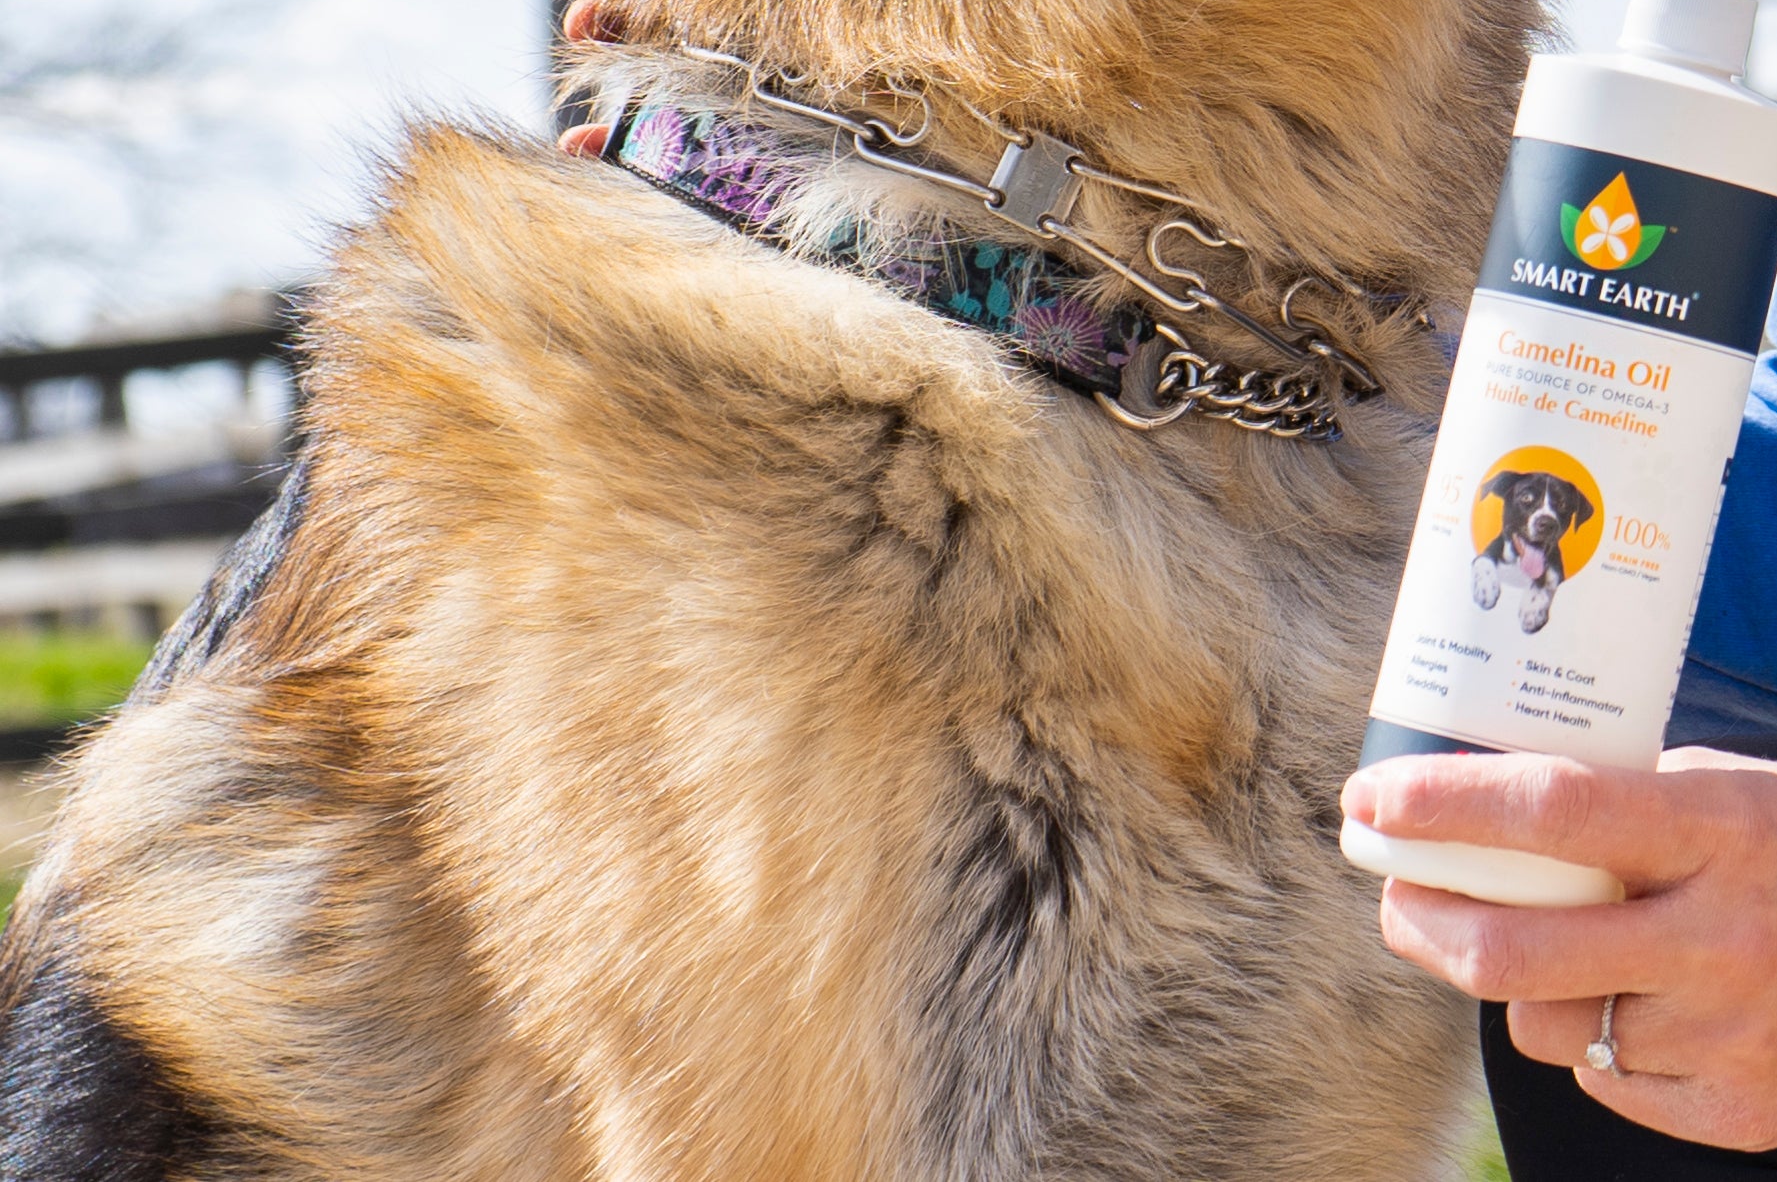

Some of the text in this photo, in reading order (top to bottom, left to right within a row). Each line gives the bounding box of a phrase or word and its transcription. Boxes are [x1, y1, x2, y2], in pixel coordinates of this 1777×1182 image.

[1511, 258, 1690, 321] SMART EARTH
[1498, 330, 1671, 392] Camelina Oil
[1484, 381, 1658, 438] Huile de Caméline
[1516, 368, 1570, 390] SOURCE
[1576, 382, 1597, 396] OF
[1602, 388, 1670, 415] OMEGA-3
[1613, 515, 1671, 550] 100%
[1438, 638, 1446, 649] &
[1448, 640, 1492, 663] Mobility
[1525, 660, 1596, 685] Skin & Coat
[1515, 701, 1592, 729] Heart Health
